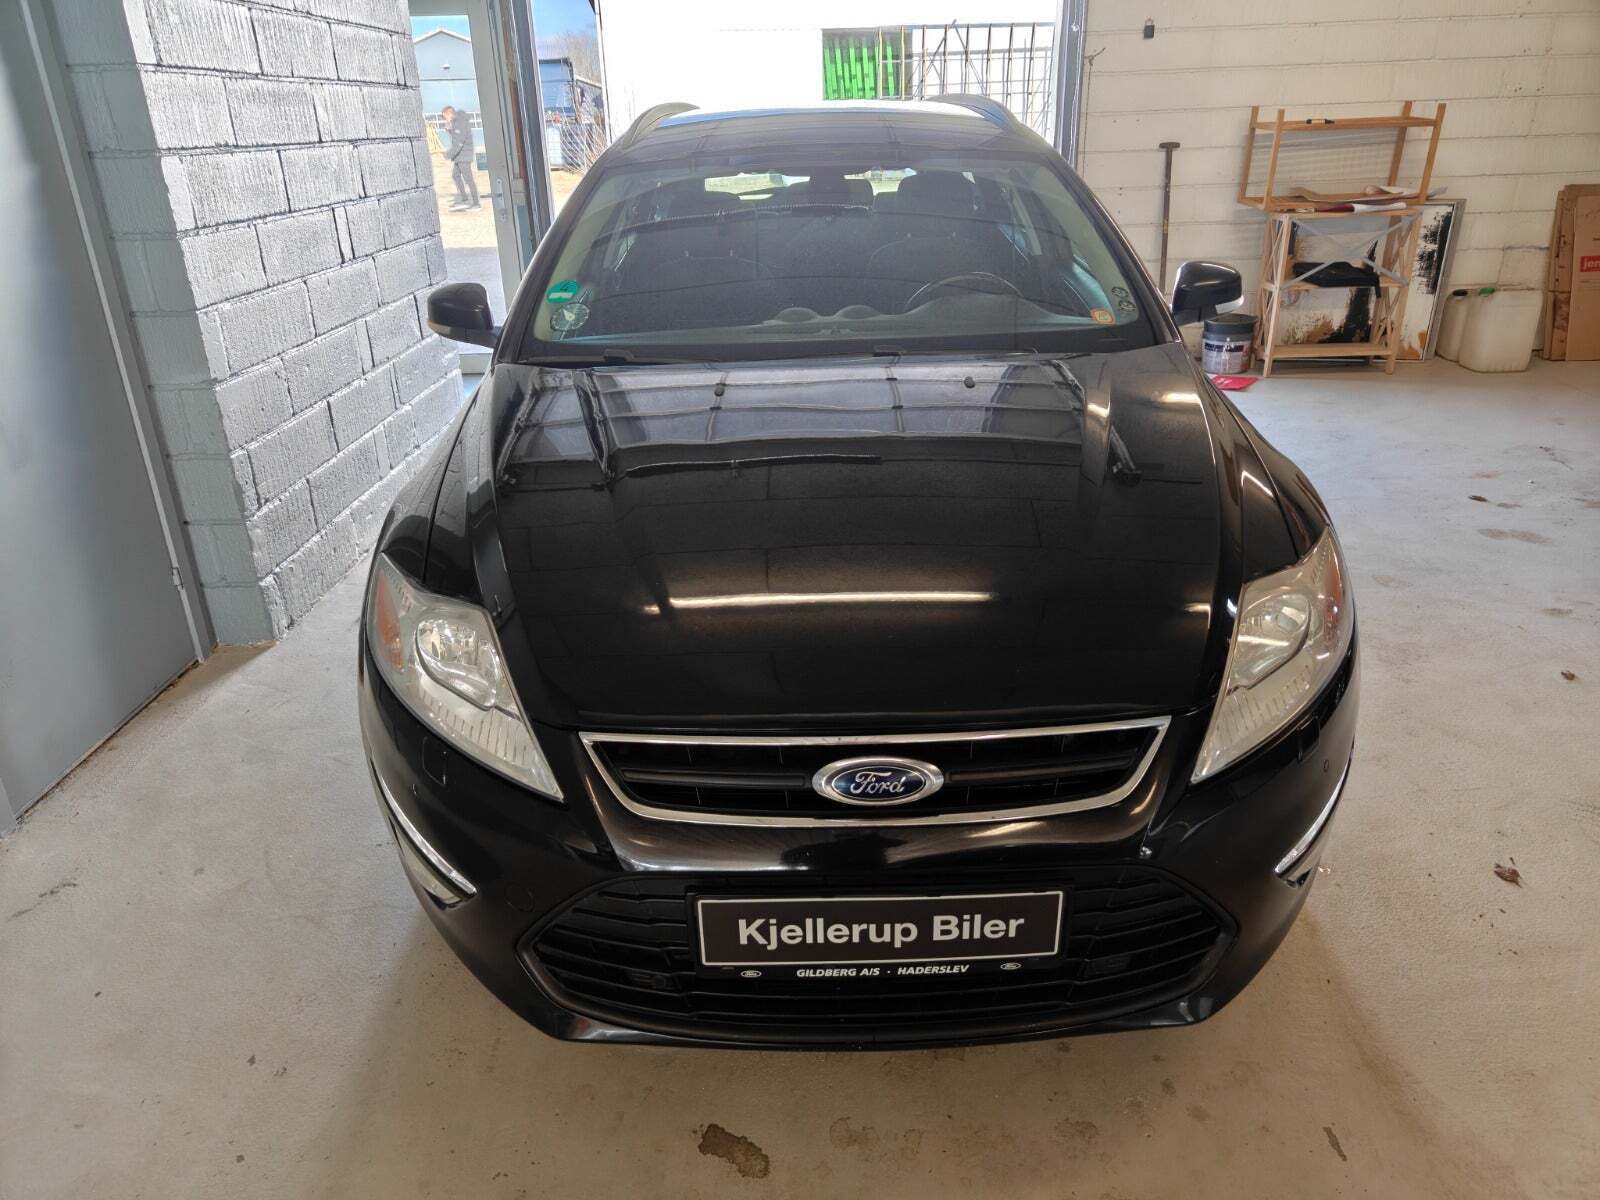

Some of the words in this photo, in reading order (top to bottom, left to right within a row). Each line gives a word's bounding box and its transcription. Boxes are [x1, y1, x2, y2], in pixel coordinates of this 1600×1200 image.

[850, 771, 906, 794] Ford
[738, 917, 918, 951] Kjellerup
[932, 913, 1025, 941] Biler
[796, 968, 857, 978] GILDBERG
[897, 964, 970, 976] HADERSLEV
